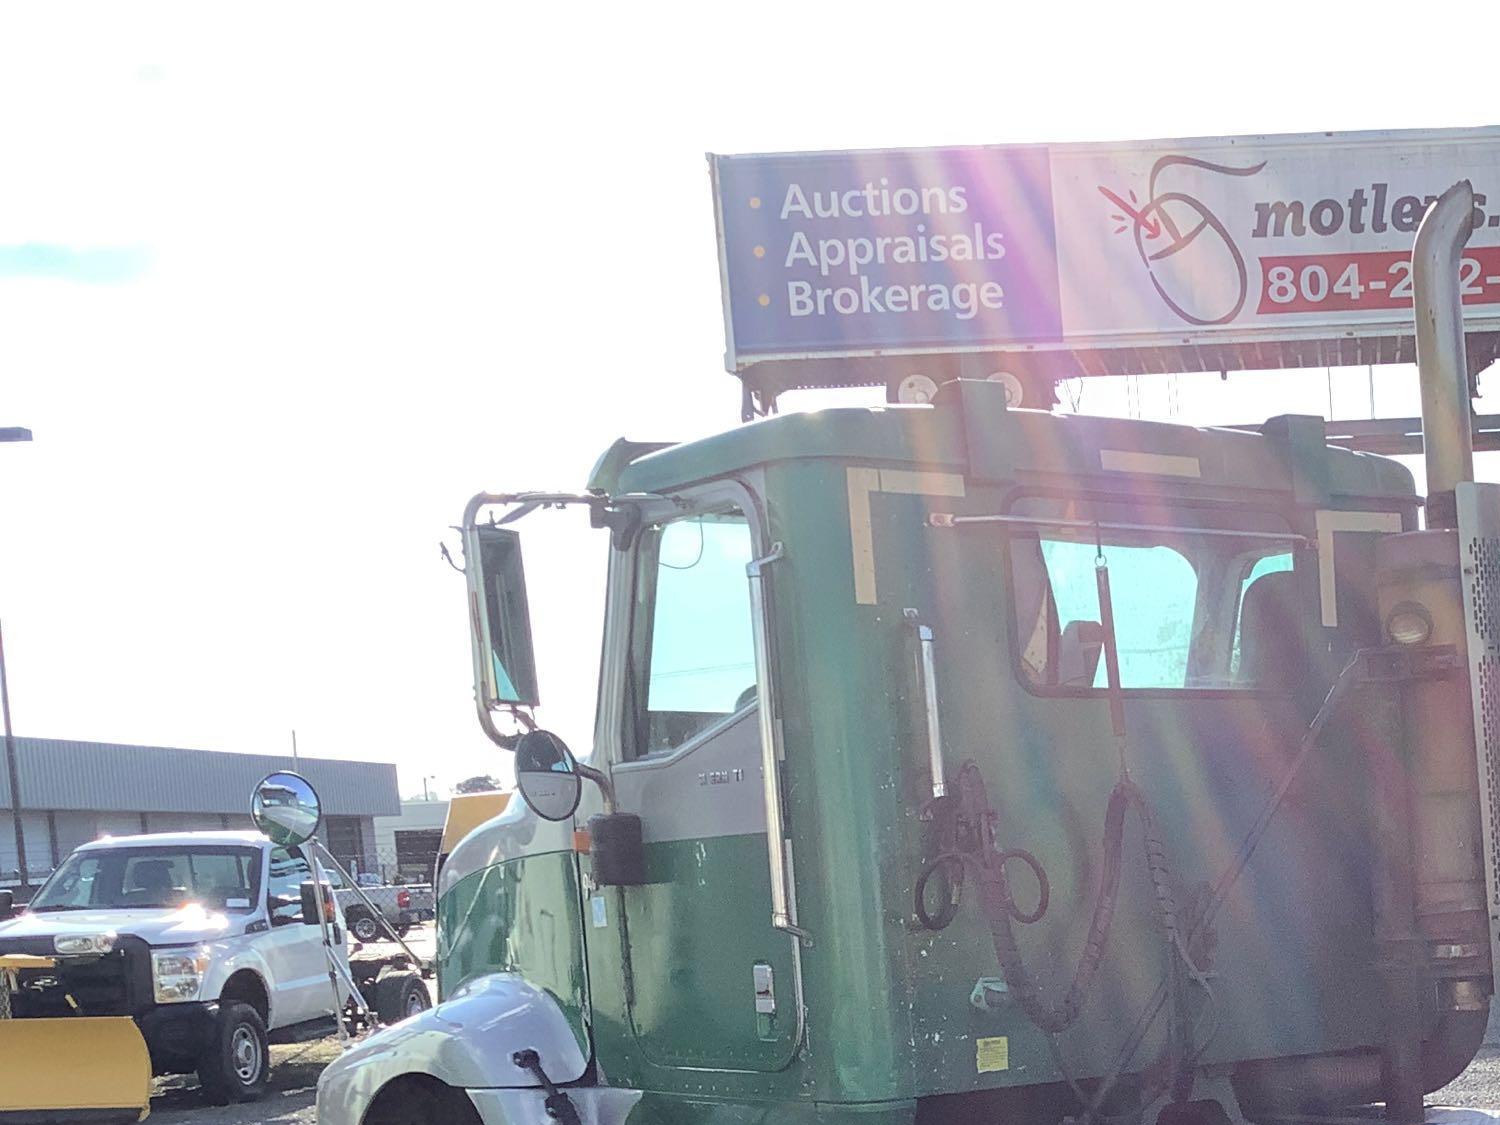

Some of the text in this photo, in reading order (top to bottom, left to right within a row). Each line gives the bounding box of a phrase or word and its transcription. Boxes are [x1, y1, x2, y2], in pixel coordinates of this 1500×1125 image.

[780, 177, 968, 220] Auctions
[785, 222, 1006, 276] Appraisals
[787, 275, 1004, 319] Brokerage
